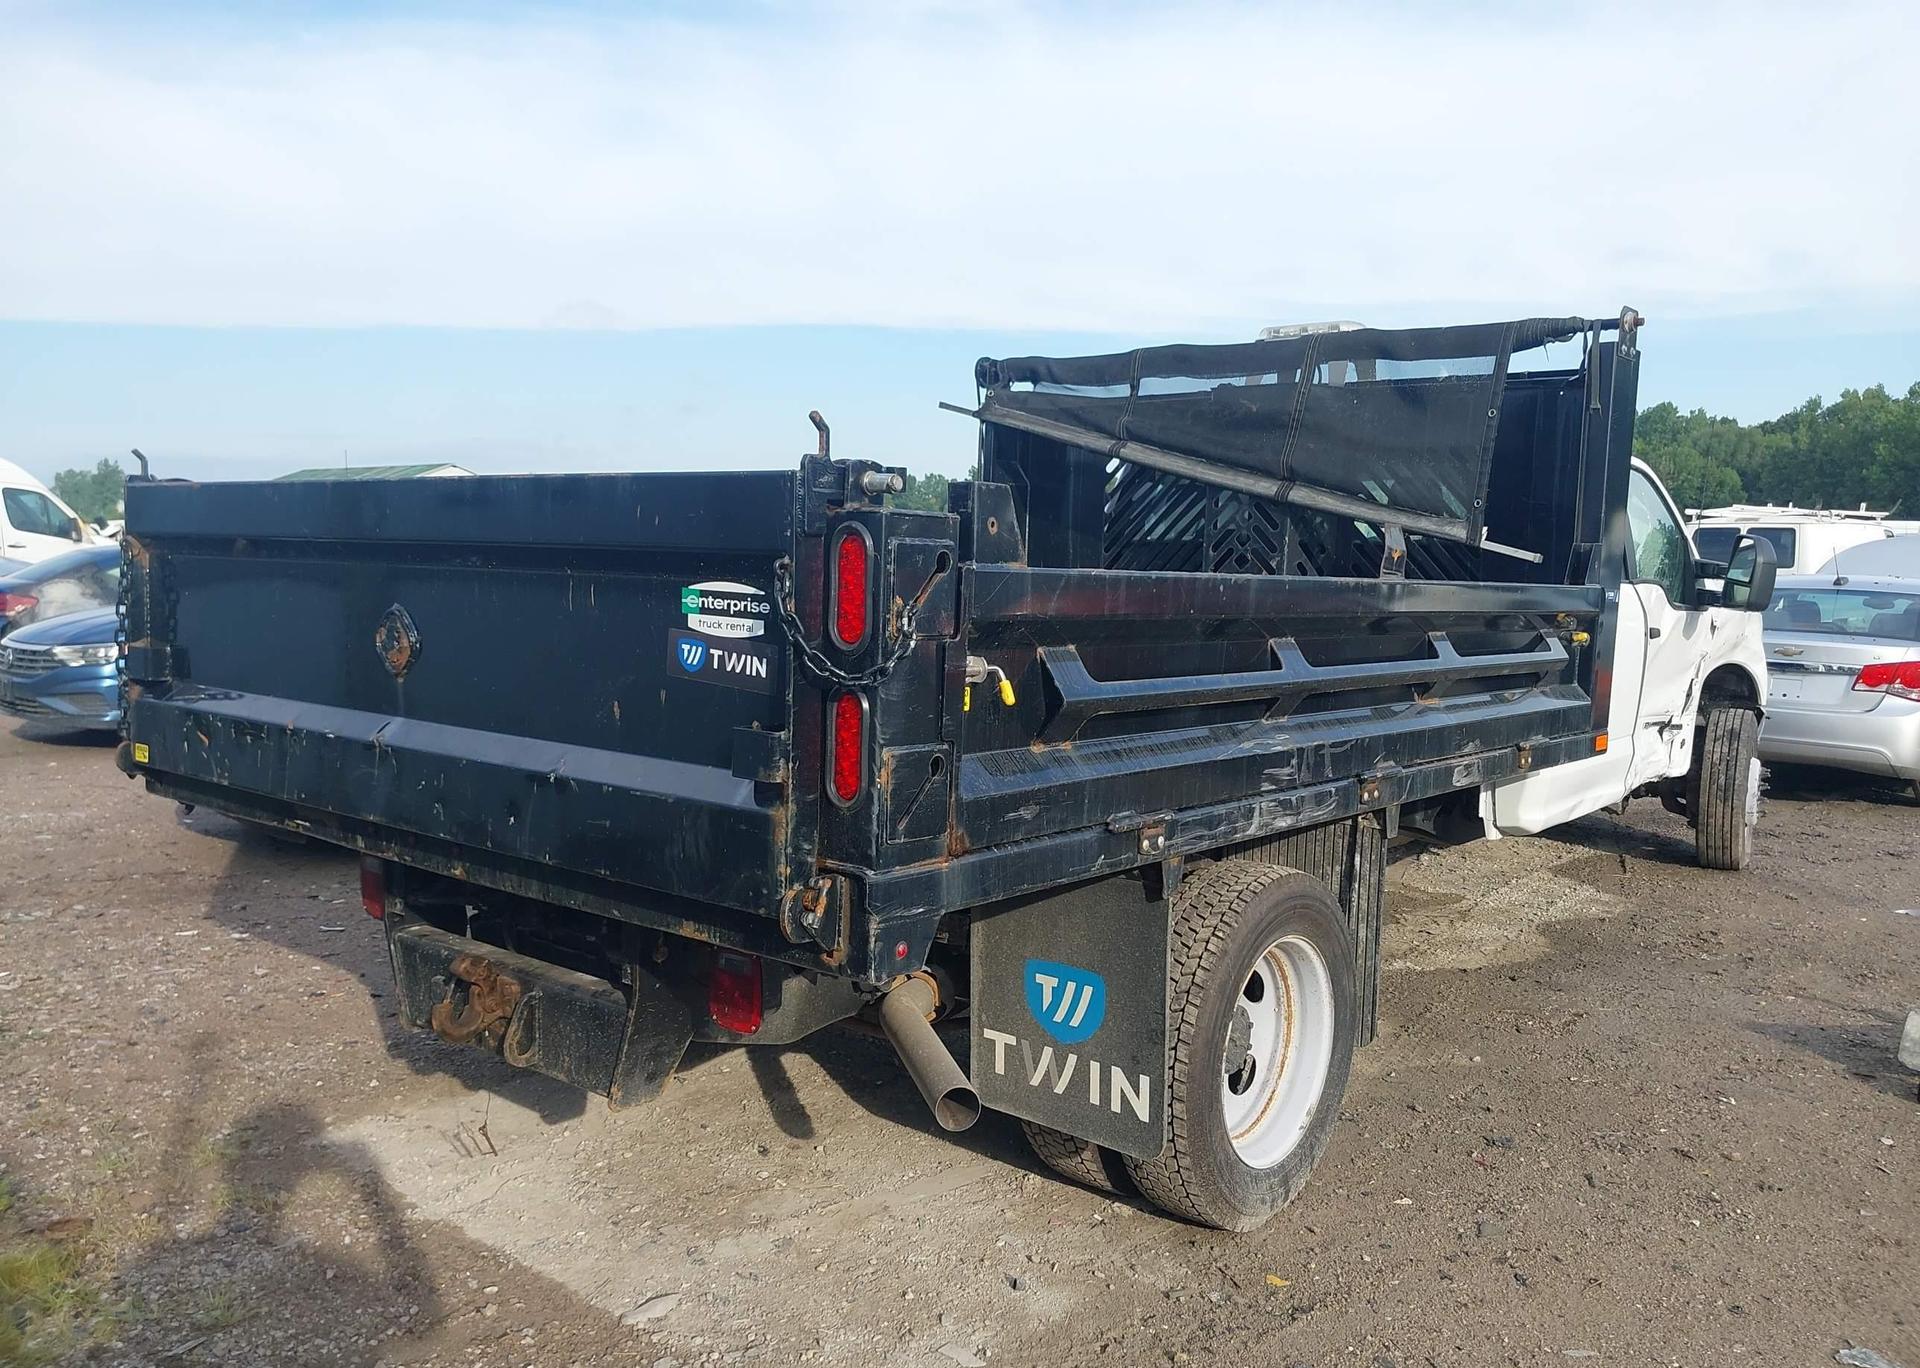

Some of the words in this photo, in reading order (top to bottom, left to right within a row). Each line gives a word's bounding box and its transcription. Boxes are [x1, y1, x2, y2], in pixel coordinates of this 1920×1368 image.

[682, 595, 771, 615] enterprise
[698, 619, 723, 629] truck
[725, 623, 754, 633] rental
[709, 648, 767, 679] TWIN
[983, 1028, 1150, 1123] TWIN
